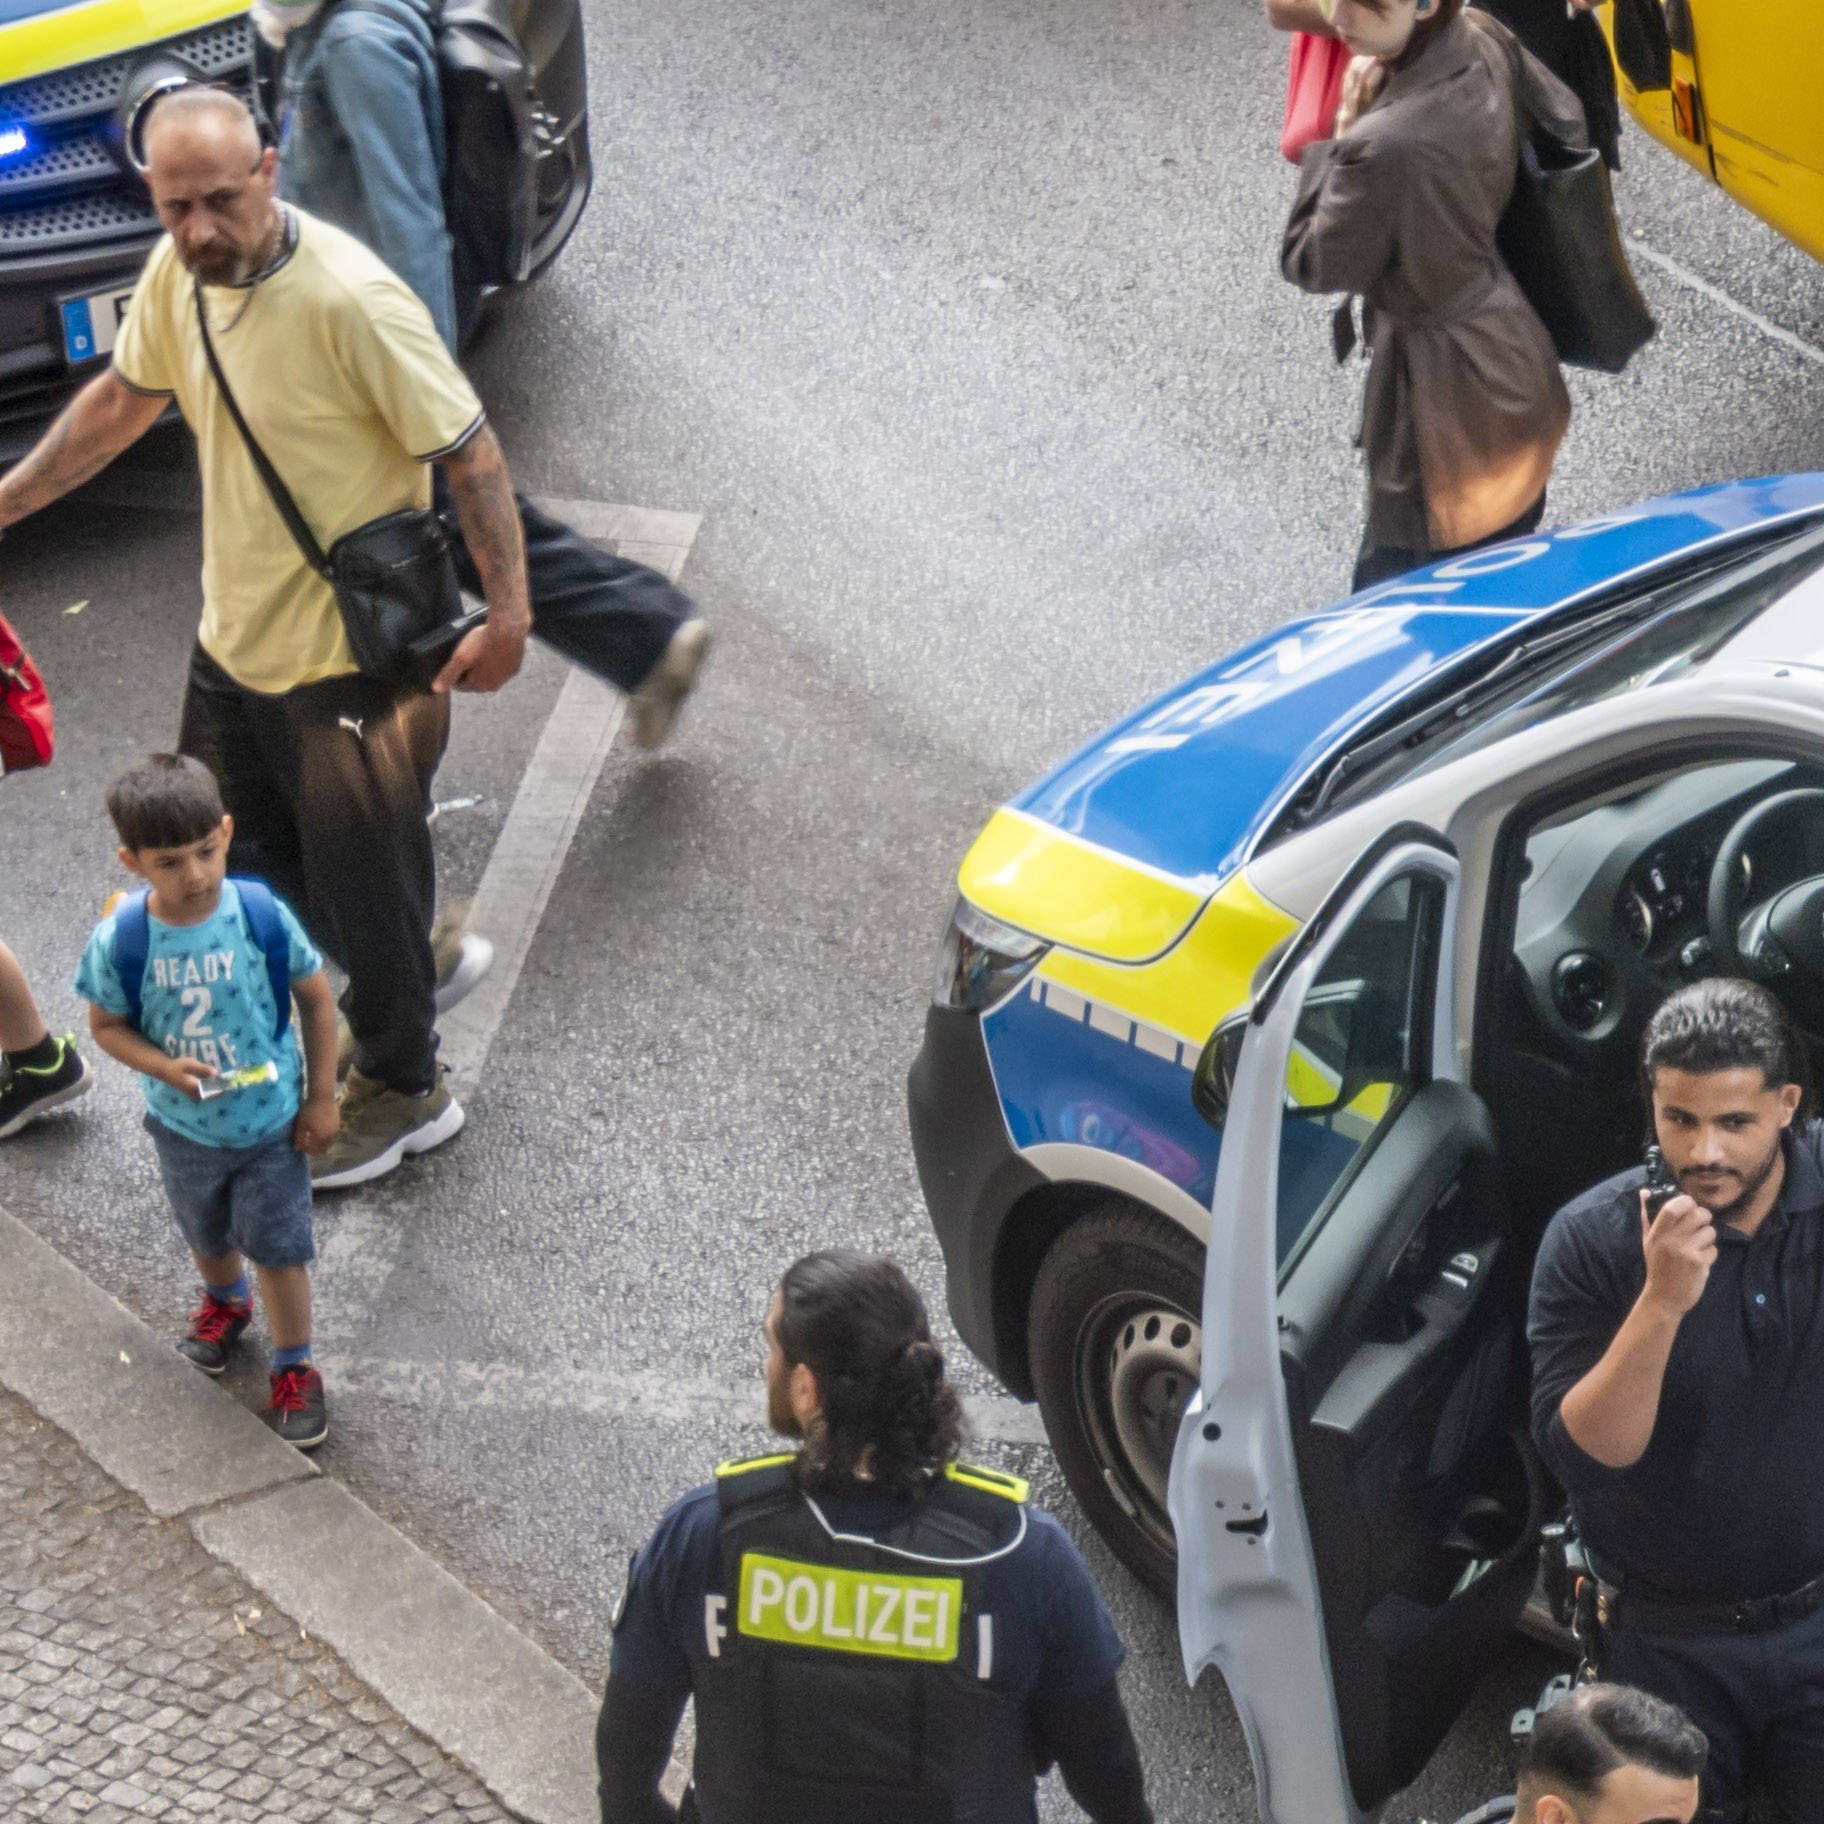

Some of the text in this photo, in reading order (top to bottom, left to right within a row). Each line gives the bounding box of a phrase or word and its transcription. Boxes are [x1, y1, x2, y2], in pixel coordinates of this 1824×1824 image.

[153, 950, 235, 988] READY
[180, 986, 213, 1037] 2
[749, 1568, 950, 1650] POLIZEI
